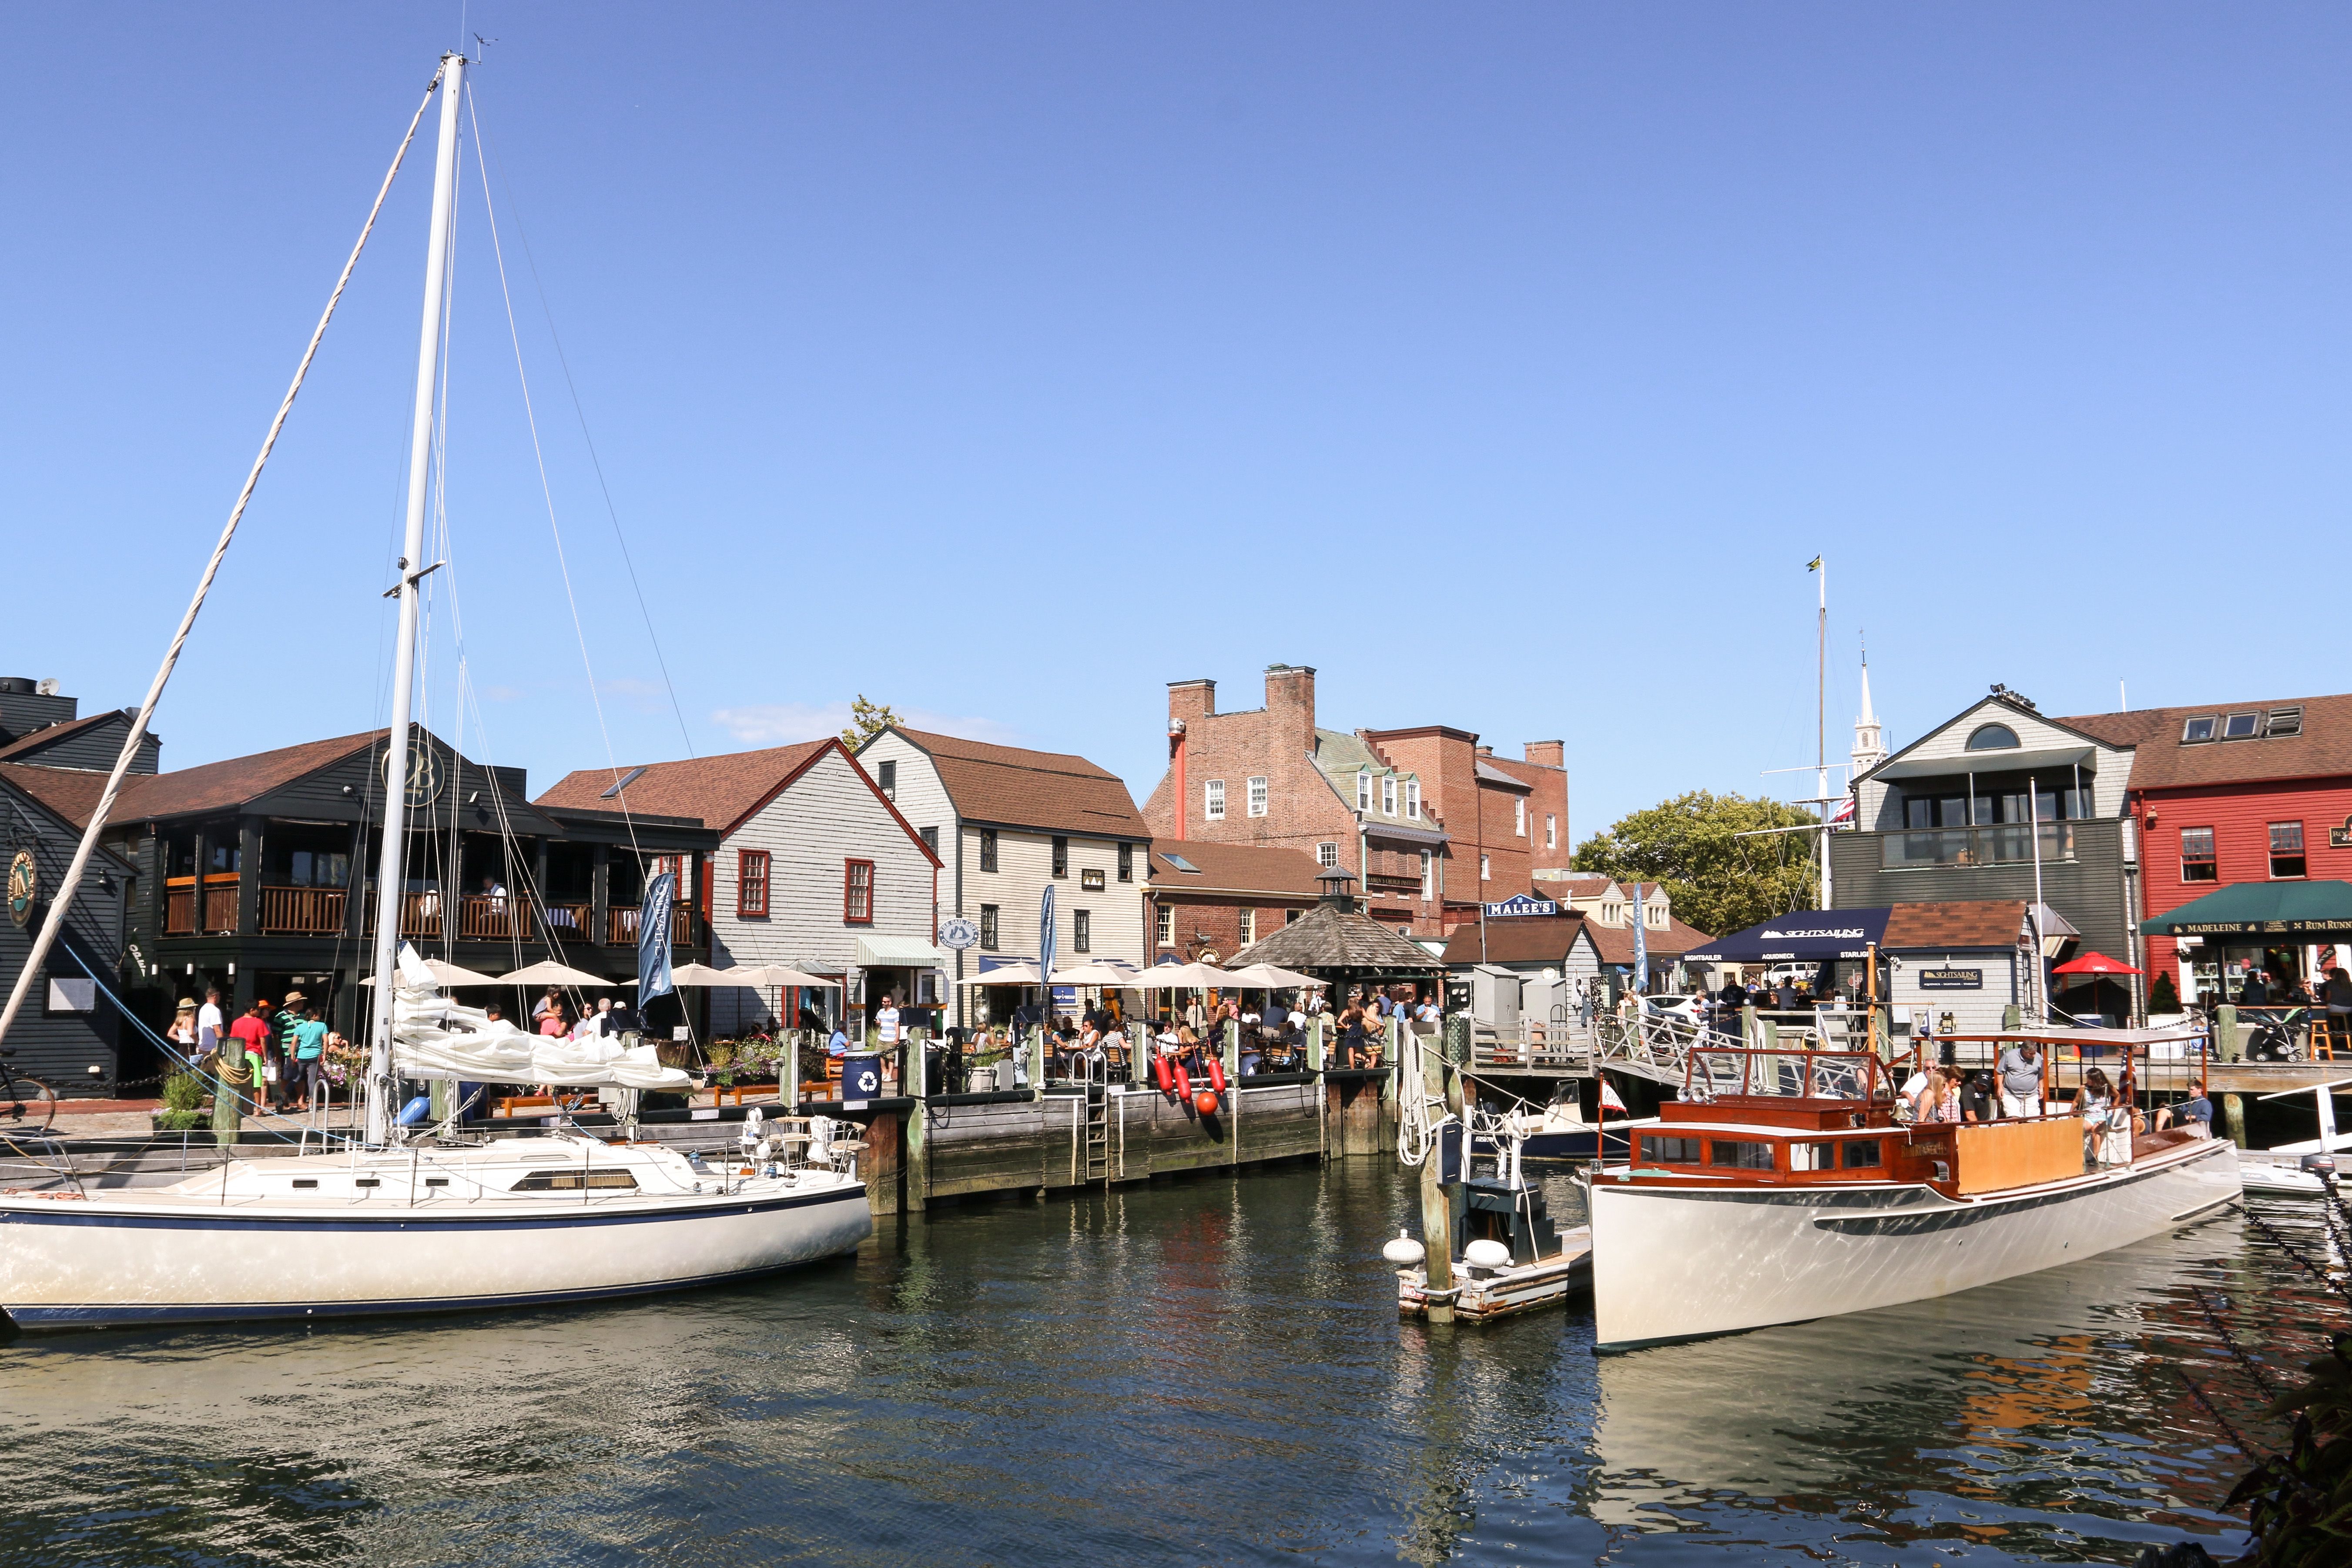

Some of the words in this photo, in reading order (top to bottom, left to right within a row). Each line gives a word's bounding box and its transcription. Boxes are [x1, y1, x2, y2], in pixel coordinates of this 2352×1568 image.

[1491, 903, 1551, 915] MALEE'S
[940, 922, 950, 931] THE
[965, 921, 978, 933] LOFT
[2188, 924, 2242, 932] MADELEINE
[2305, 921, 2326, 930] RUM
[1784, 928, 1865, 937] SIGHTSAILING
[941, 938, 967, 949] CLOTHING
[1403, 1287, 1416, 1297] NO
